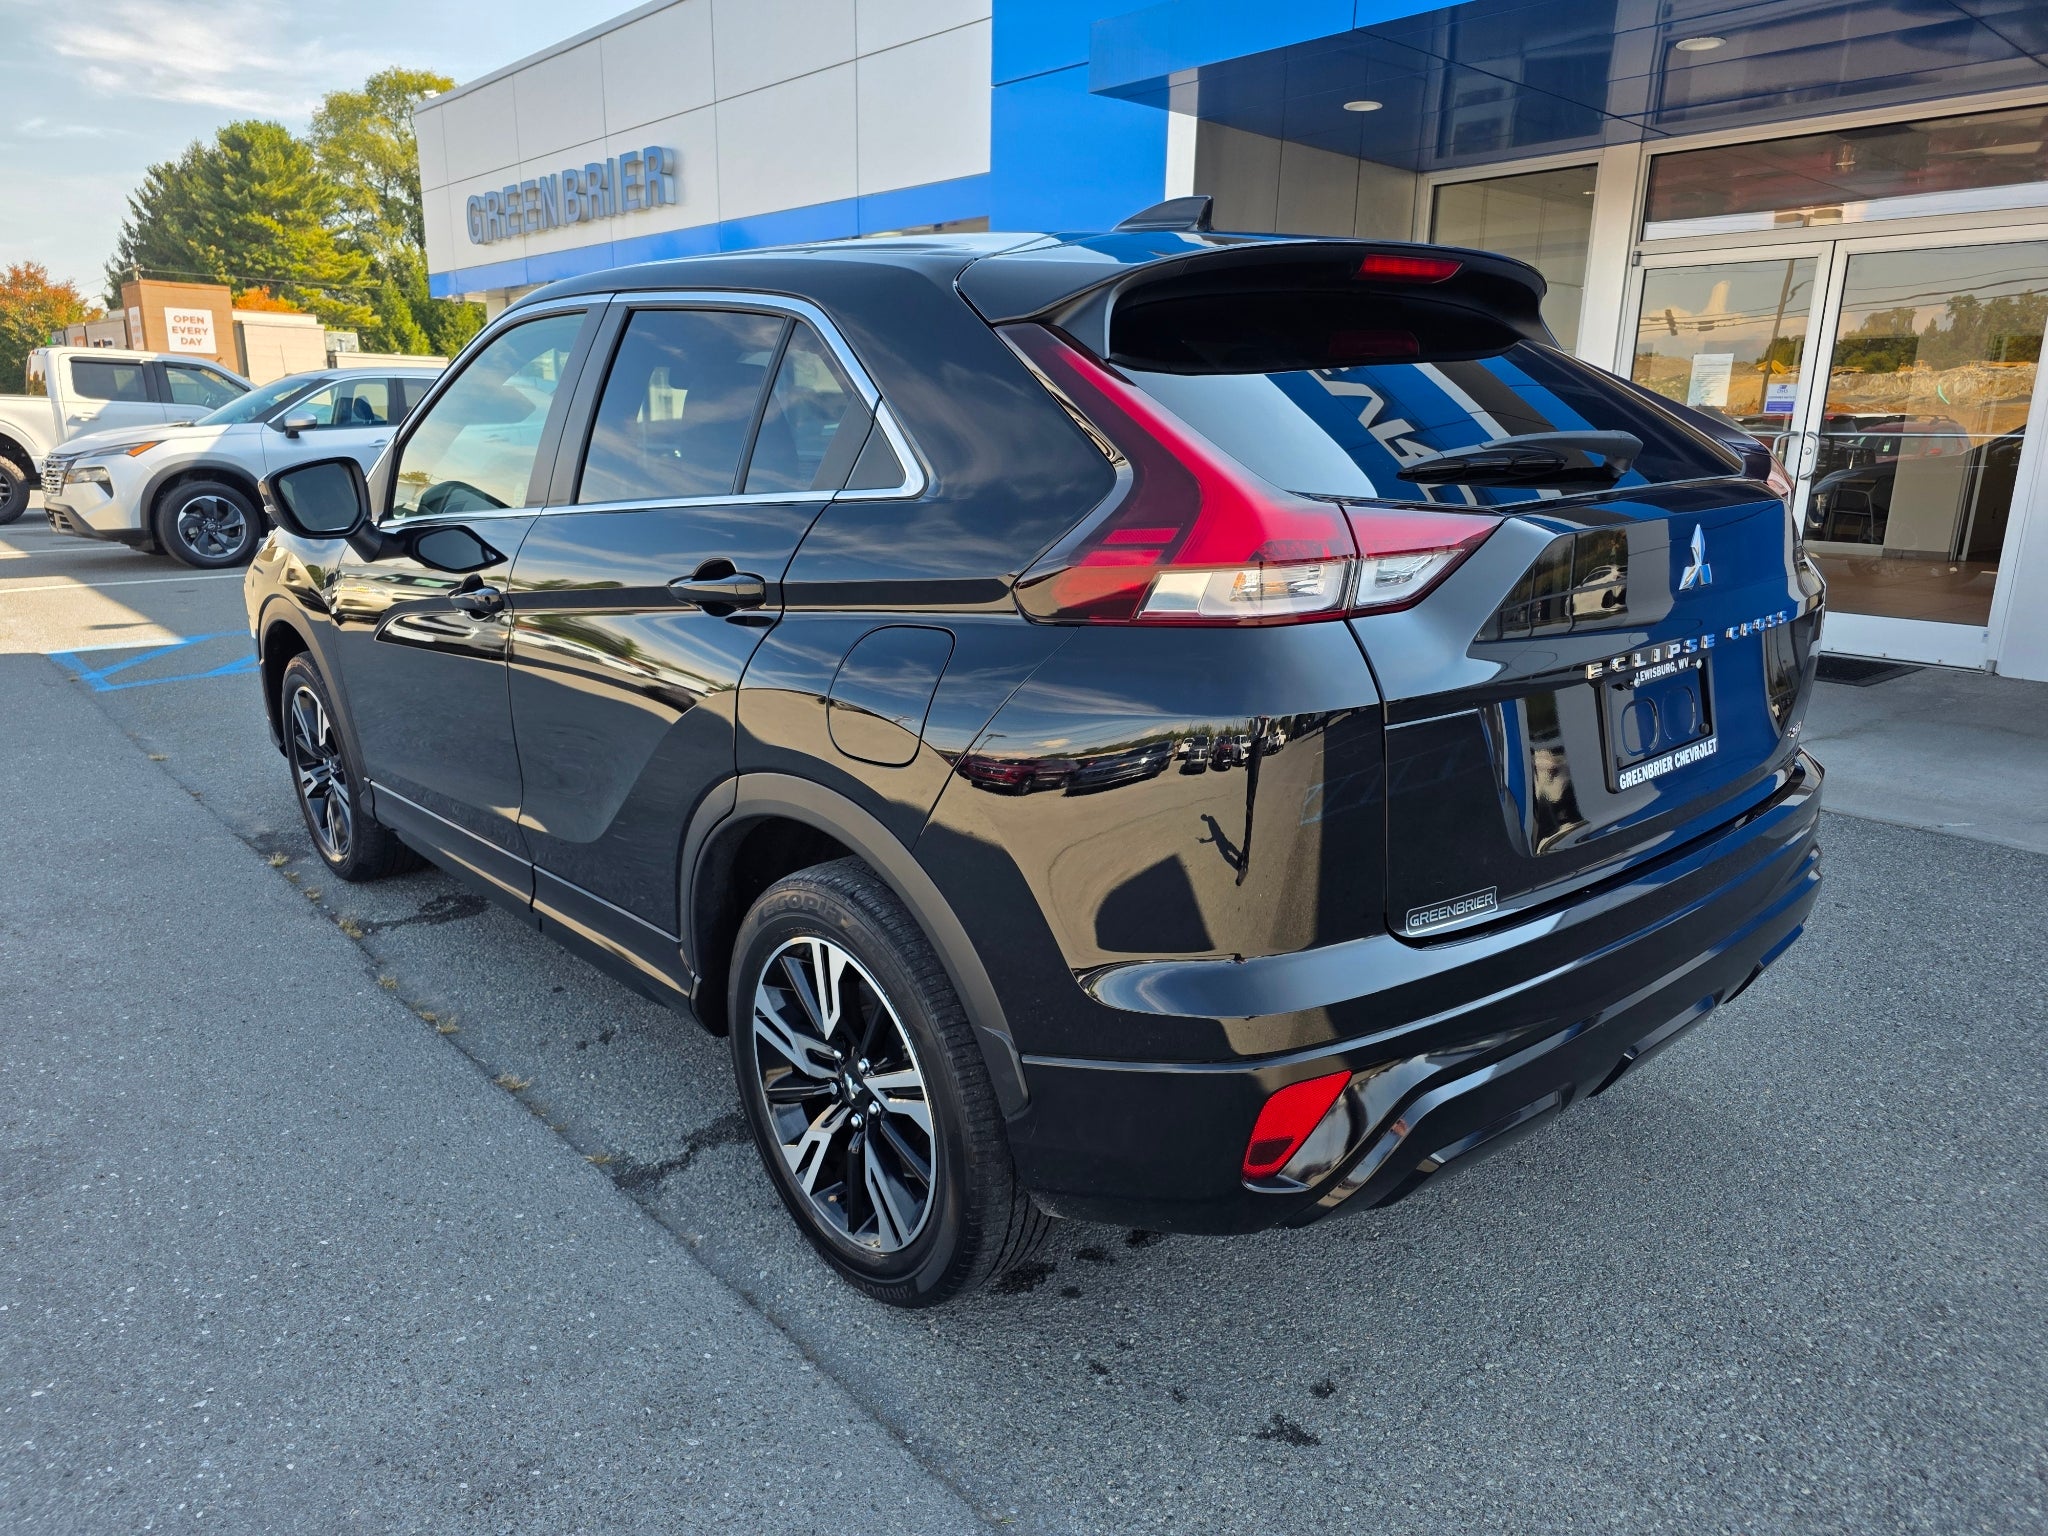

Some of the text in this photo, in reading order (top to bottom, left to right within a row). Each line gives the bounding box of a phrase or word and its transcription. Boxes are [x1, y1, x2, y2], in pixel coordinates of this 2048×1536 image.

[466, 145, 674, 245] GREENBRIER
[171, 326, 209, 336] EVERY
[173, 314, 205, 325] OPEN
[180, 337, 203, 346] DAY
[1585, 610, 1788, 680] ECLIPSE CROSS
[1677, 657, 1690, 670] WV
[1619, 738, 1717, 790] GREENBRIER CHEVROLET
[1409, 892, 1494, 927] GREENBRIER
